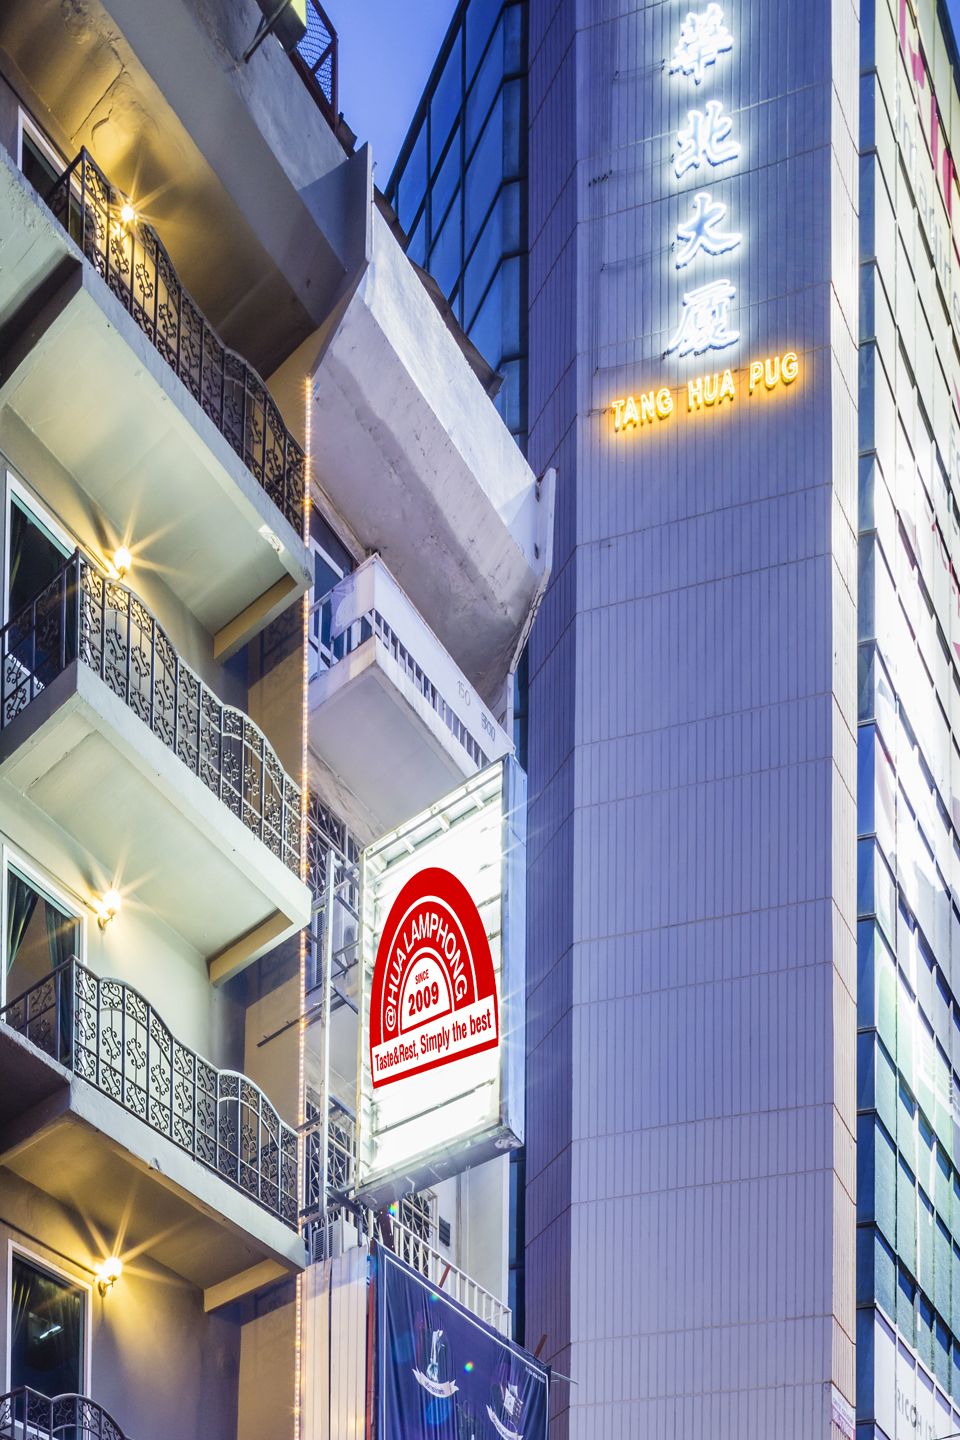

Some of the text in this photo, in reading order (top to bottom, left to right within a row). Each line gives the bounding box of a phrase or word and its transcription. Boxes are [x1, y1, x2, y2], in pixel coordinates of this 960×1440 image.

[611, 351, 799, 432] TANG HUA PUG
[403, 912, 468, 1001] LAMPHONG
[415, 969, 429, 984] SINCE
[408, 982, 439, 1017] 2009
[374, 1008, 492, 1072] Taste&Rest, Simply the best
